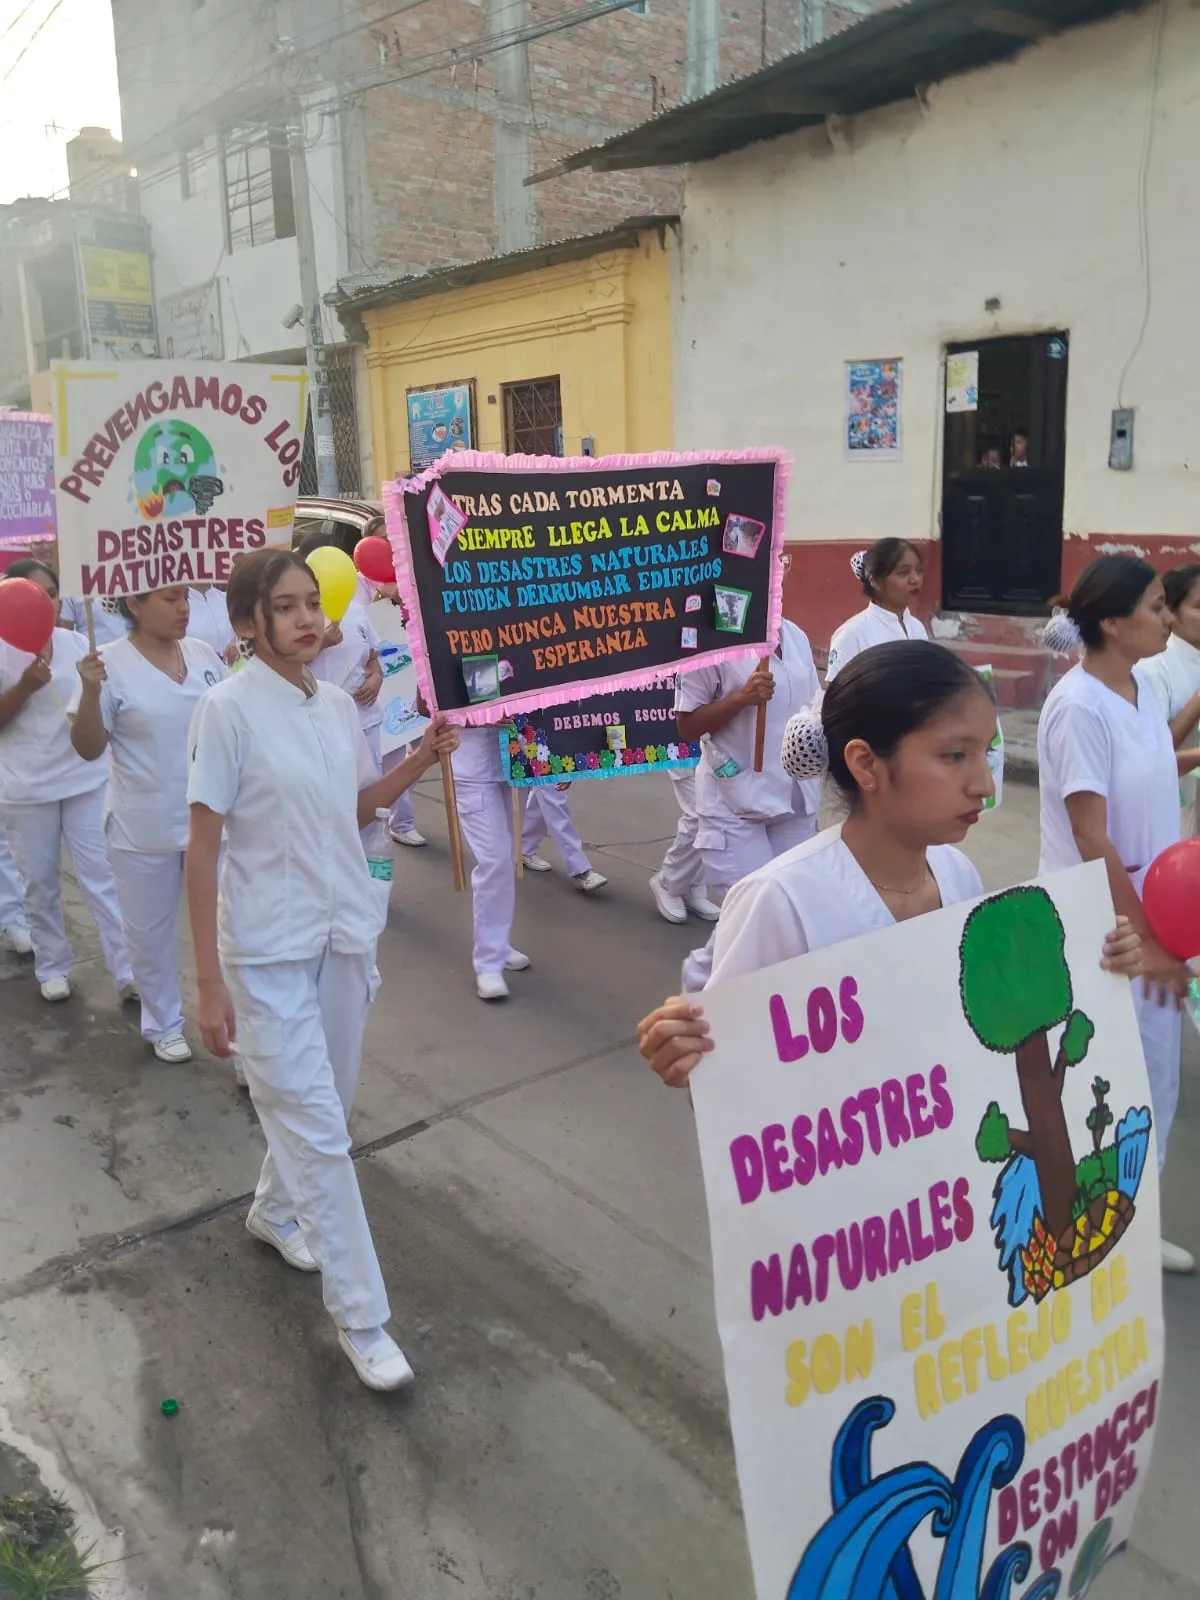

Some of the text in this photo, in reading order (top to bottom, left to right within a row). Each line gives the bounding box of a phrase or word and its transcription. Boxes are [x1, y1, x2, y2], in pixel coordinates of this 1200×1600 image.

[60, 376, 267, 504] PREVENGAMOS
[264, 420, 300, 488] LOS
[452, 479, 684, 516] TRAS CADA TORMENTA
[457, 506, 721, 551] SIEMPRE LLEGA LA CALMA
[97, 518, 266, 562] DESASTRES
[444, 536, 709, 583] LOS DESASTRES NATURALES
[517, 574, 631, 607] DERRUMBAR
[638, 557, 722, 591] EDIFICIOS
[445, 597, 676, 655] PERO NUNCA NUESTRA
[532, 627, 648, 671] ESPERANZA
[553, 712, 620, 731] DEBEMOS
[769, 976, 864, 1063] LOS
[729, 1064, 953, 1205] DESASTRES
[751, 1177, 974, 1321] NATURALES
[784, 1281, 946, 1408] SON EL
[913, 1254, 1130, 1421] REFLEJO DE
[1024, 1315, 1149, 1445] NUESTRA
[1039, 1449, 1138, 1573] ON DEL
